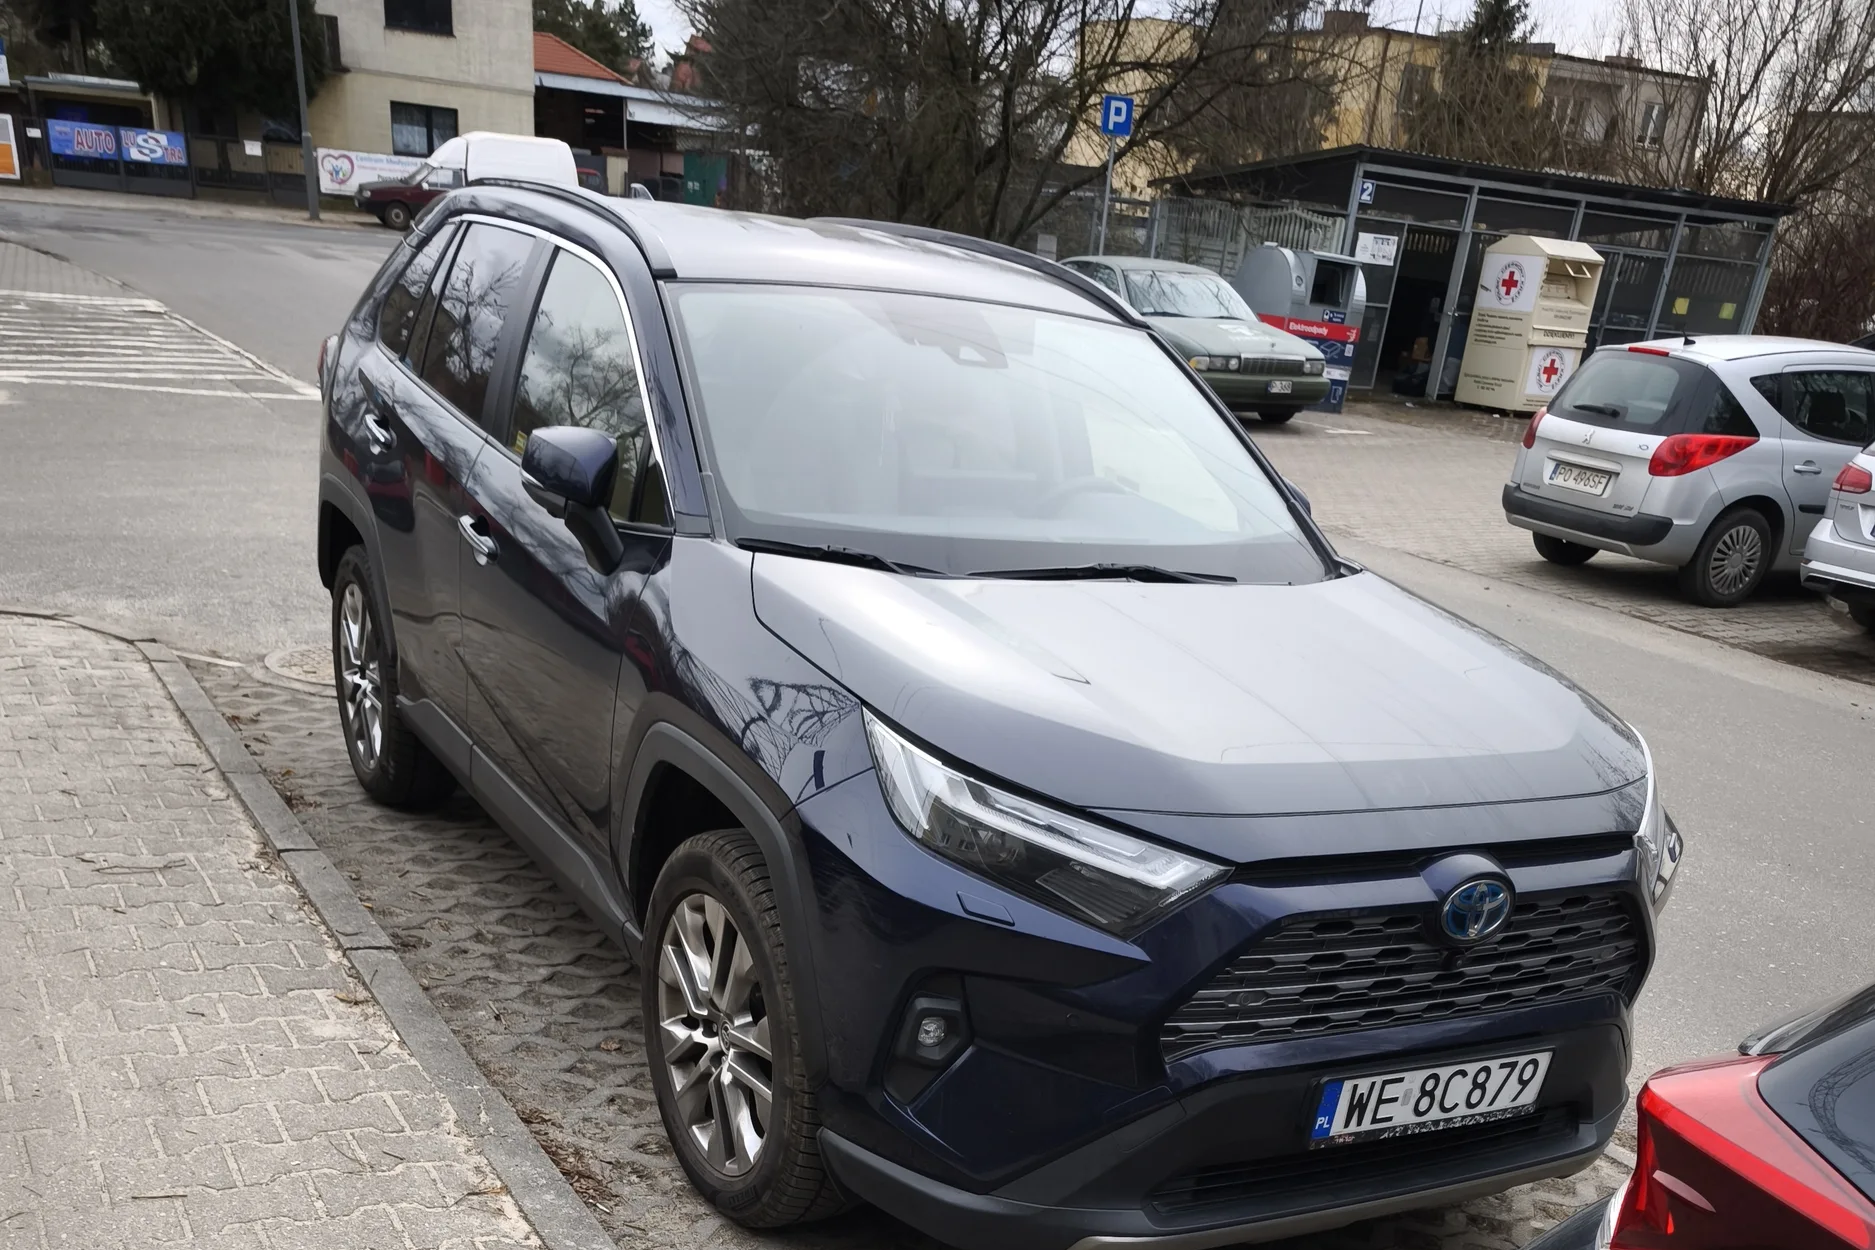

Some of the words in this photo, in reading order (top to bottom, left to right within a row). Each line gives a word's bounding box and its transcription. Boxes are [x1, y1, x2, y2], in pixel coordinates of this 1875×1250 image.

[1108, 100, 1127, 130] P
[74, 127, 116, 154] AUTO
[1360, 182, 1373, 201] 2
[1557, 465, 1571, 483] PO
[1573, 471, 1607, 490] 496SF
[1343, 1076, 1405, 1130] WE
[1413, 1058, 1540, 1117] 8C879
[1315, 1116, 1331, 1130] PL
